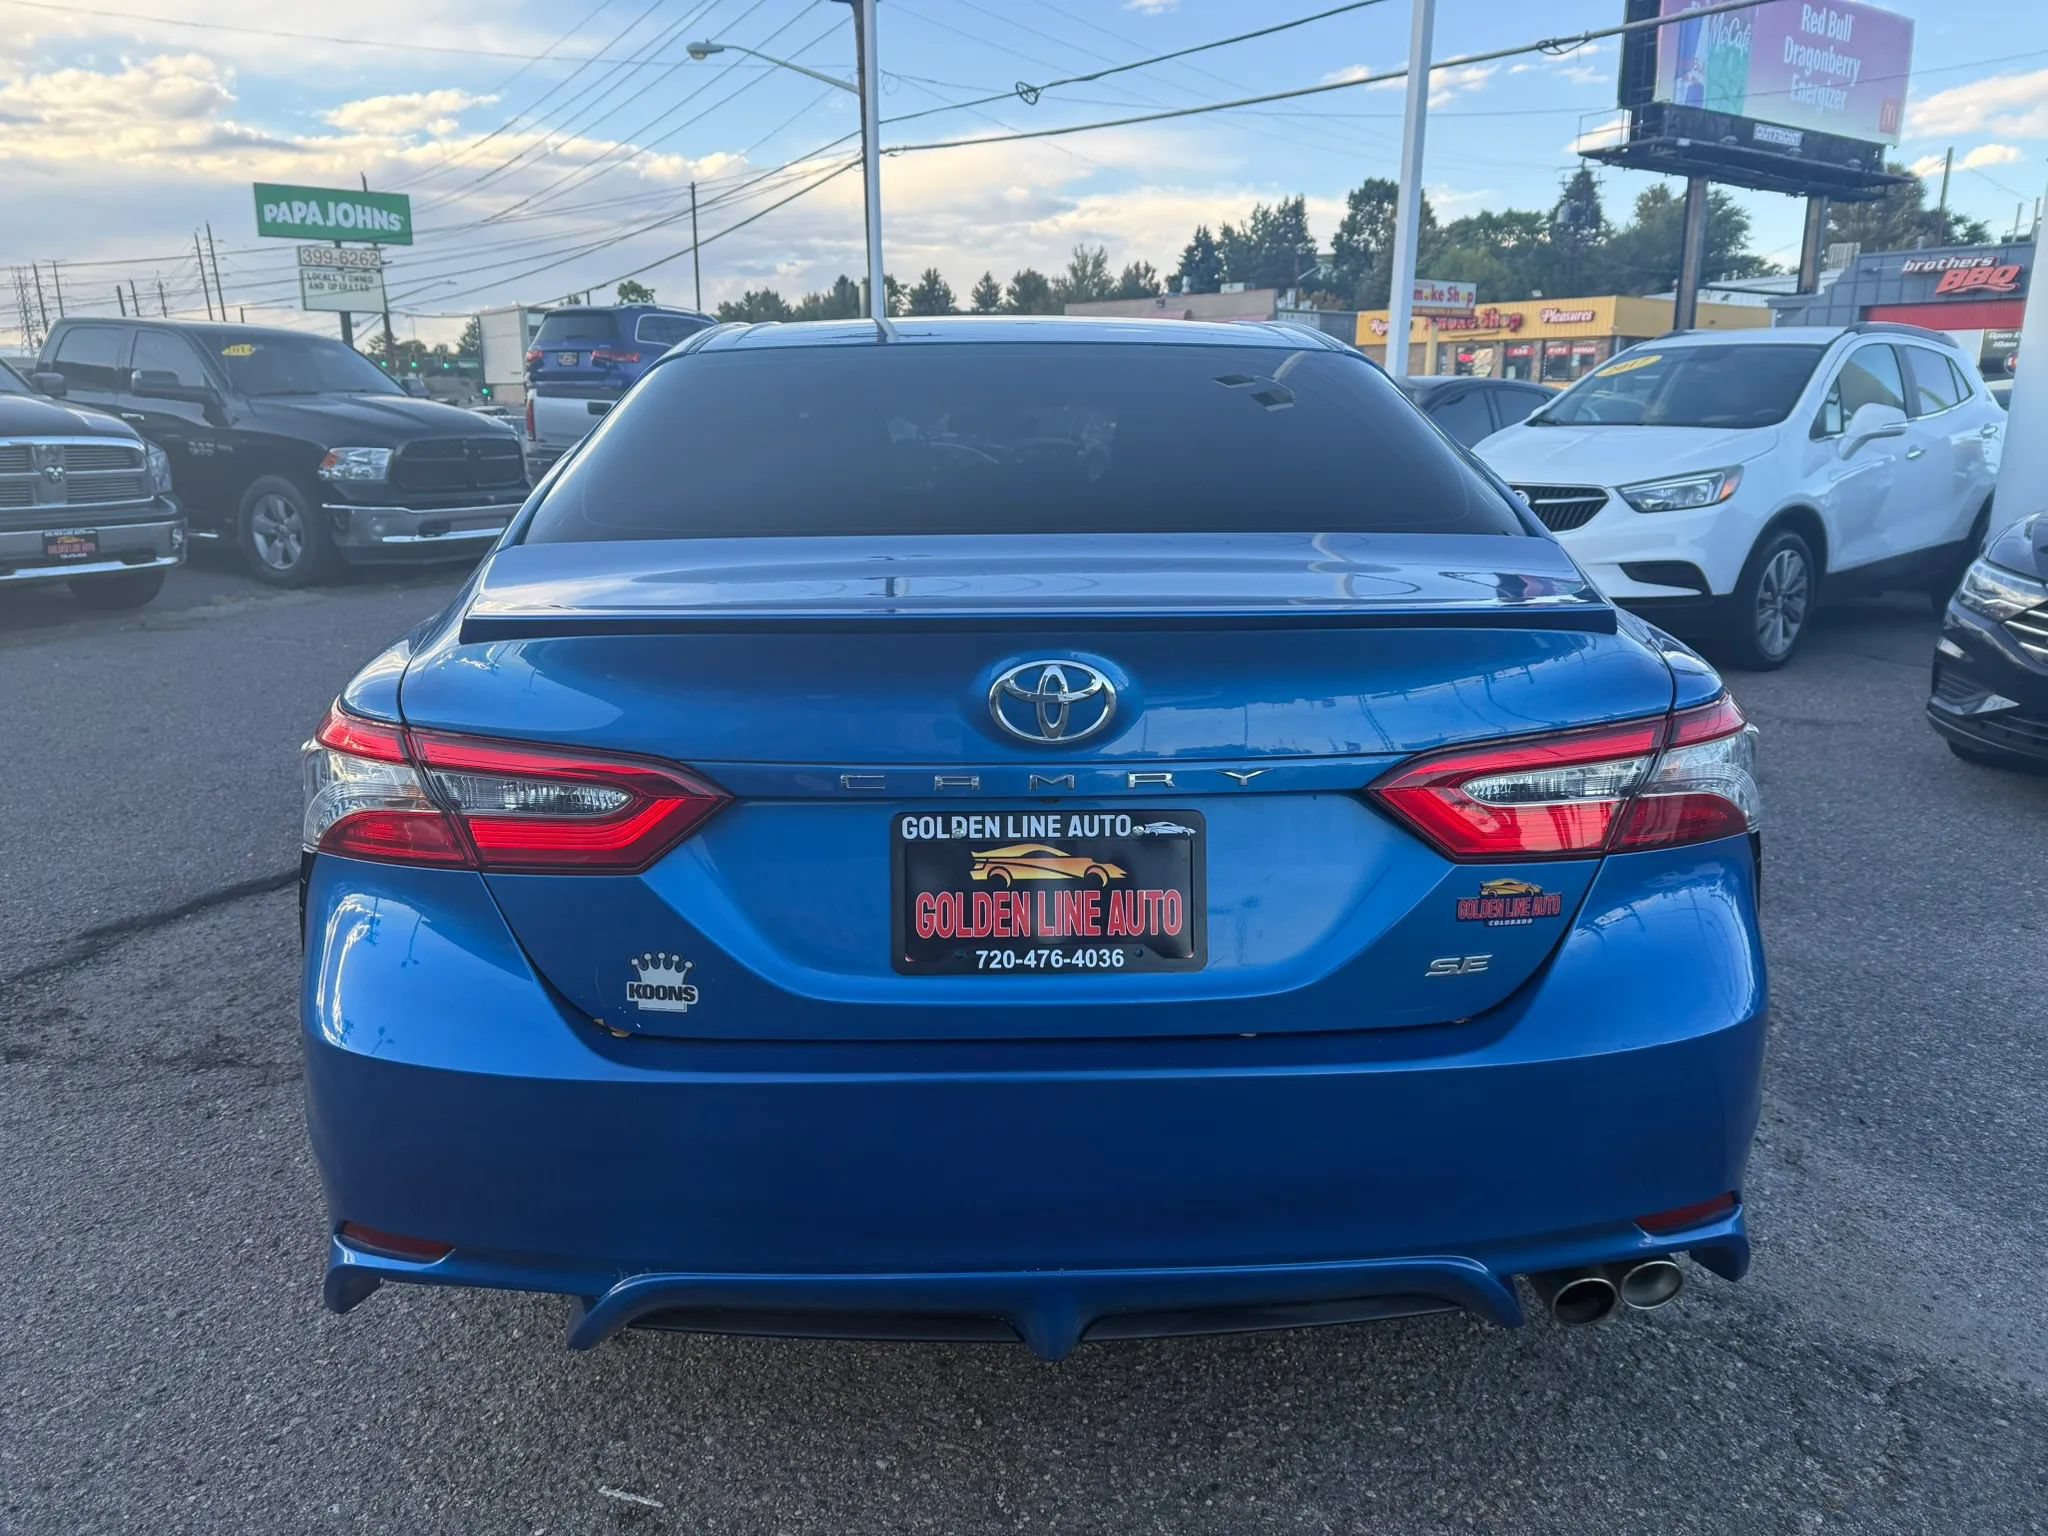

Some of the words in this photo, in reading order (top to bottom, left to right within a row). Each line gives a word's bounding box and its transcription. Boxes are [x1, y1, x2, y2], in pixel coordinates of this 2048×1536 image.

[1801, 3, 1827, 36] Red
[1827, 10, 1853, 42] Bull
[1784, 35, 1861, 87] Dragonberry
[1791, 73, 1848, 115] Energizer
[263, 201, 325, 226] PAPA
[326, 201, 402, 231] JOHNS
[303, 249, 378, 267] 399-6262
[1902, 256, 1996, 272] brothers
[308, 282, 324, 290] AND
[1936, 264, 2021, 293] BBQ
[1414, 284, 1445, 302] moke
[1541, 308, 1595, 324] Pleasures
[839, 767, 1275, 791] CAMRY
[901, 815, 1001, 840] GOLDEN
[1007, 816, 1061, 838] LINE
[1067, 813, 1131, 837] AUTO
[915, 890, 1031, 939] GOLDEN
[1038, 890, 1101, 938] LINE
[1107, 888, 1183, 936] AUTO
[1457, 899, 1504, 920] GOLDEN
[1505, 897, 1531, 918] LINE
[1532, 895, 1561, 916] AUTO
[1488, 918, 1533, 926] COLORADO
[975, 948, 1125, 969] 720-476-4036
[1424, 954, 1493, 976] SE
[628, 983, 696, 1002] KOONS
